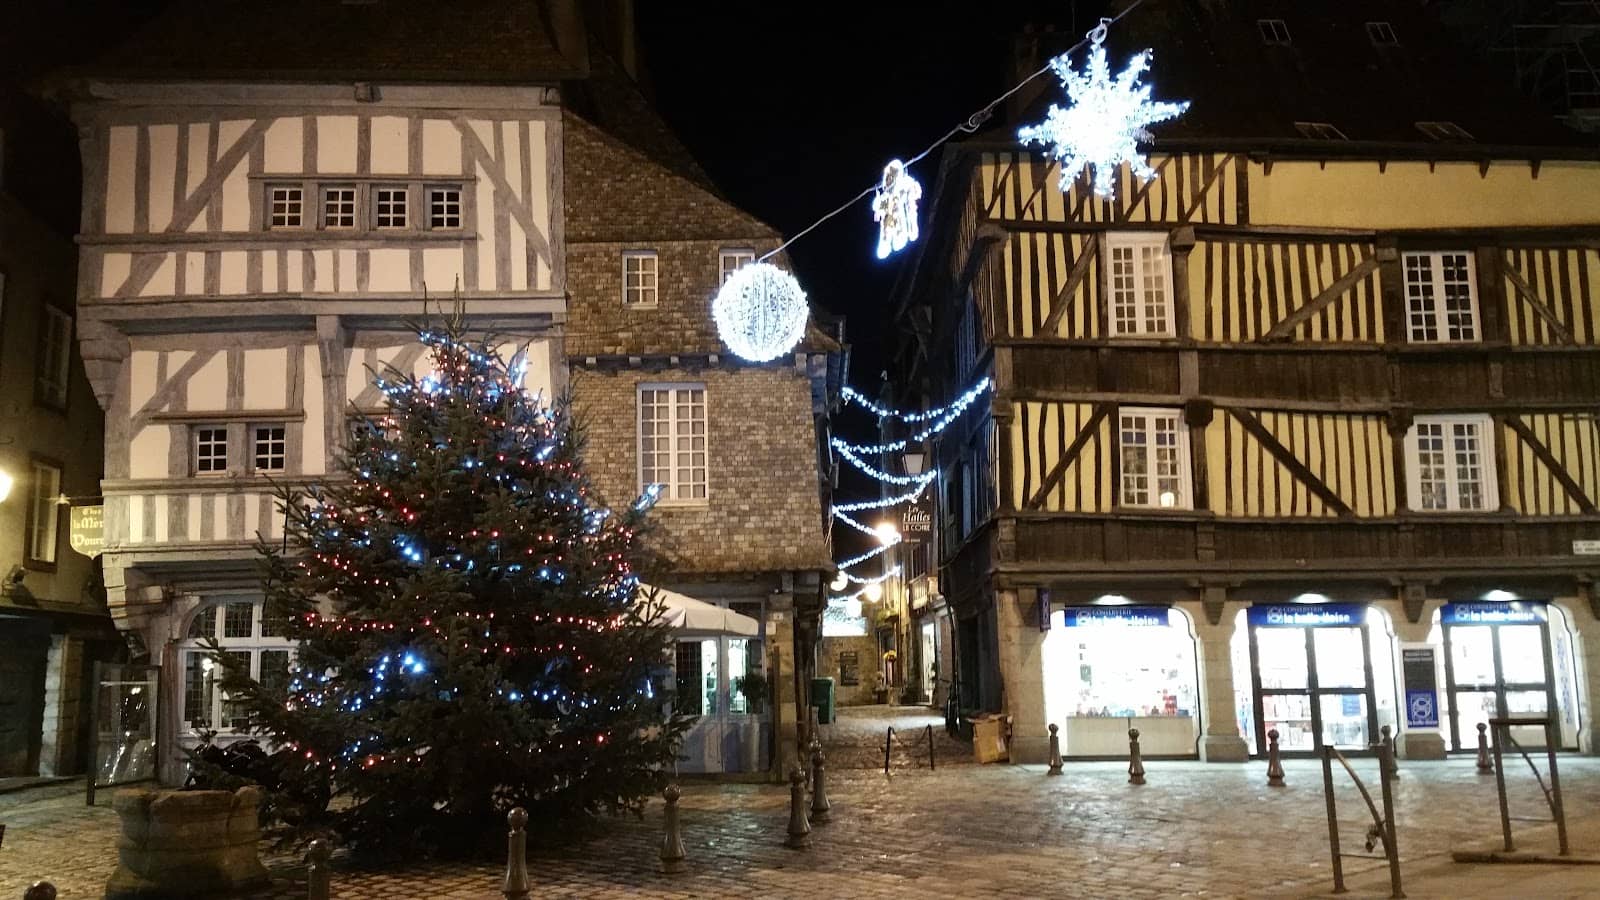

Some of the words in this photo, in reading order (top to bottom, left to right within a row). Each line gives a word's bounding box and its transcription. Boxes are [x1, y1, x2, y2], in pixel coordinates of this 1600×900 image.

[903, 510, 931, 522] Halles
[81, 517, 104, 529] Mèr
[73, 534, 104, 547] Pourc
